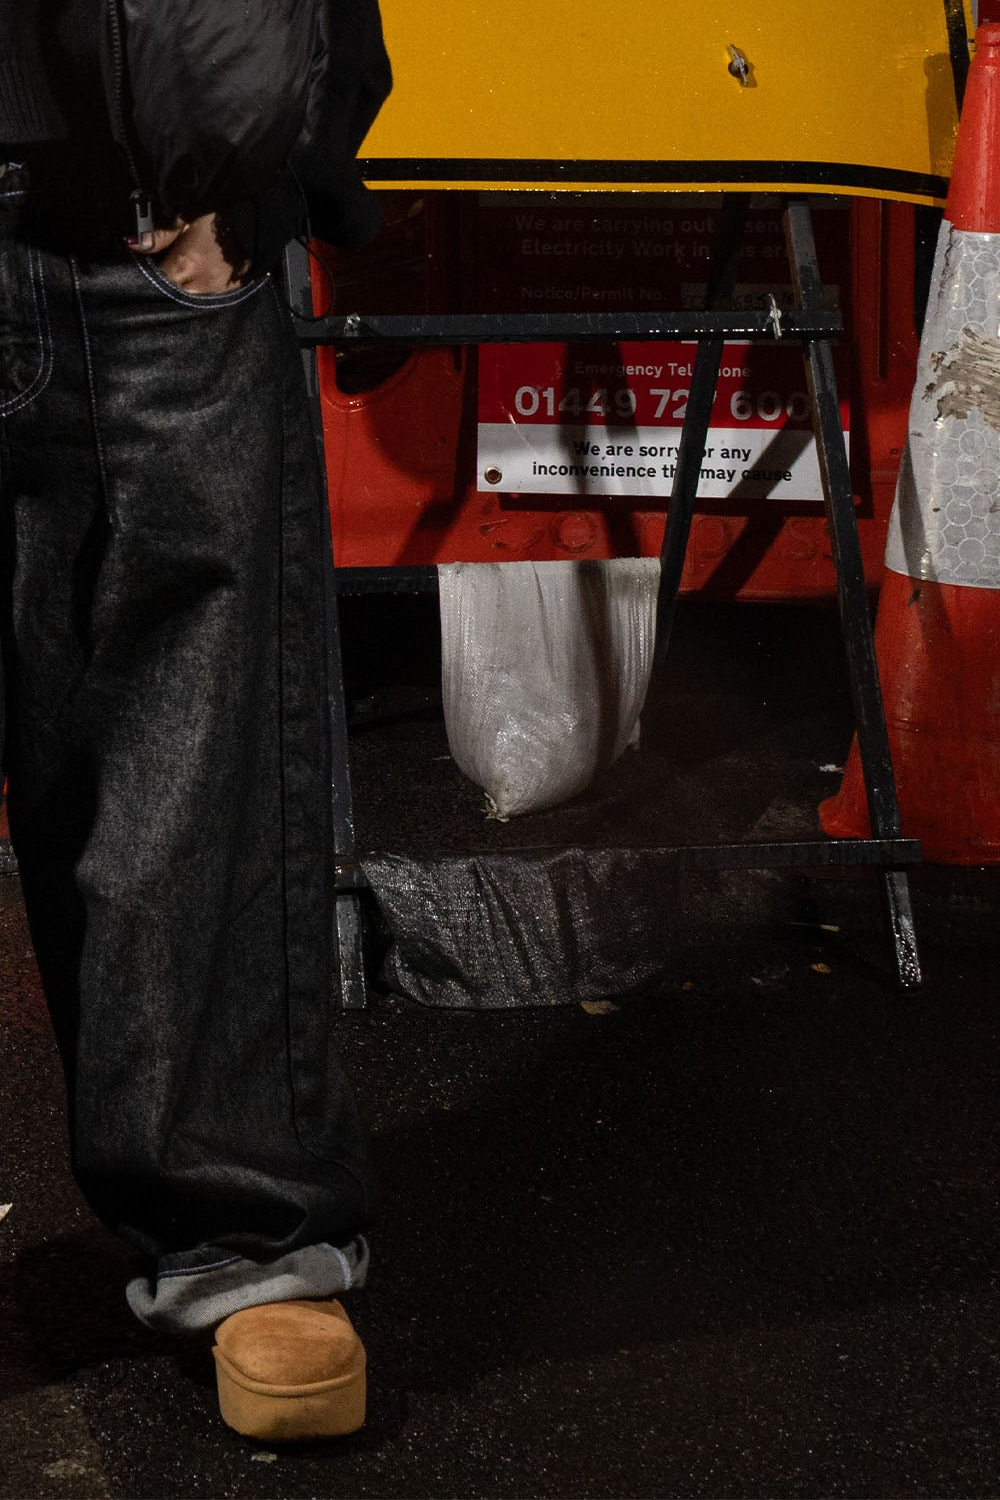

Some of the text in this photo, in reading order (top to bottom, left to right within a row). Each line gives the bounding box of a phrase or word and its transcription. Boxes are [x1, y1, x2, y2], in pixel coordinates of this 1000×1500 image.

[575, 362, 663, 378] Emergency
[514, 386, 636, 419] 01449
[730, 390, 813, 421] 600
[574, 441, 600, 456] We
[606, 444, 632, 457] are
[720, 447, 751, 462] any
[532, 461, 657, 478] inconvenience
[700, 468, 736, 482] may
[741, 468, 793, 482] cause
